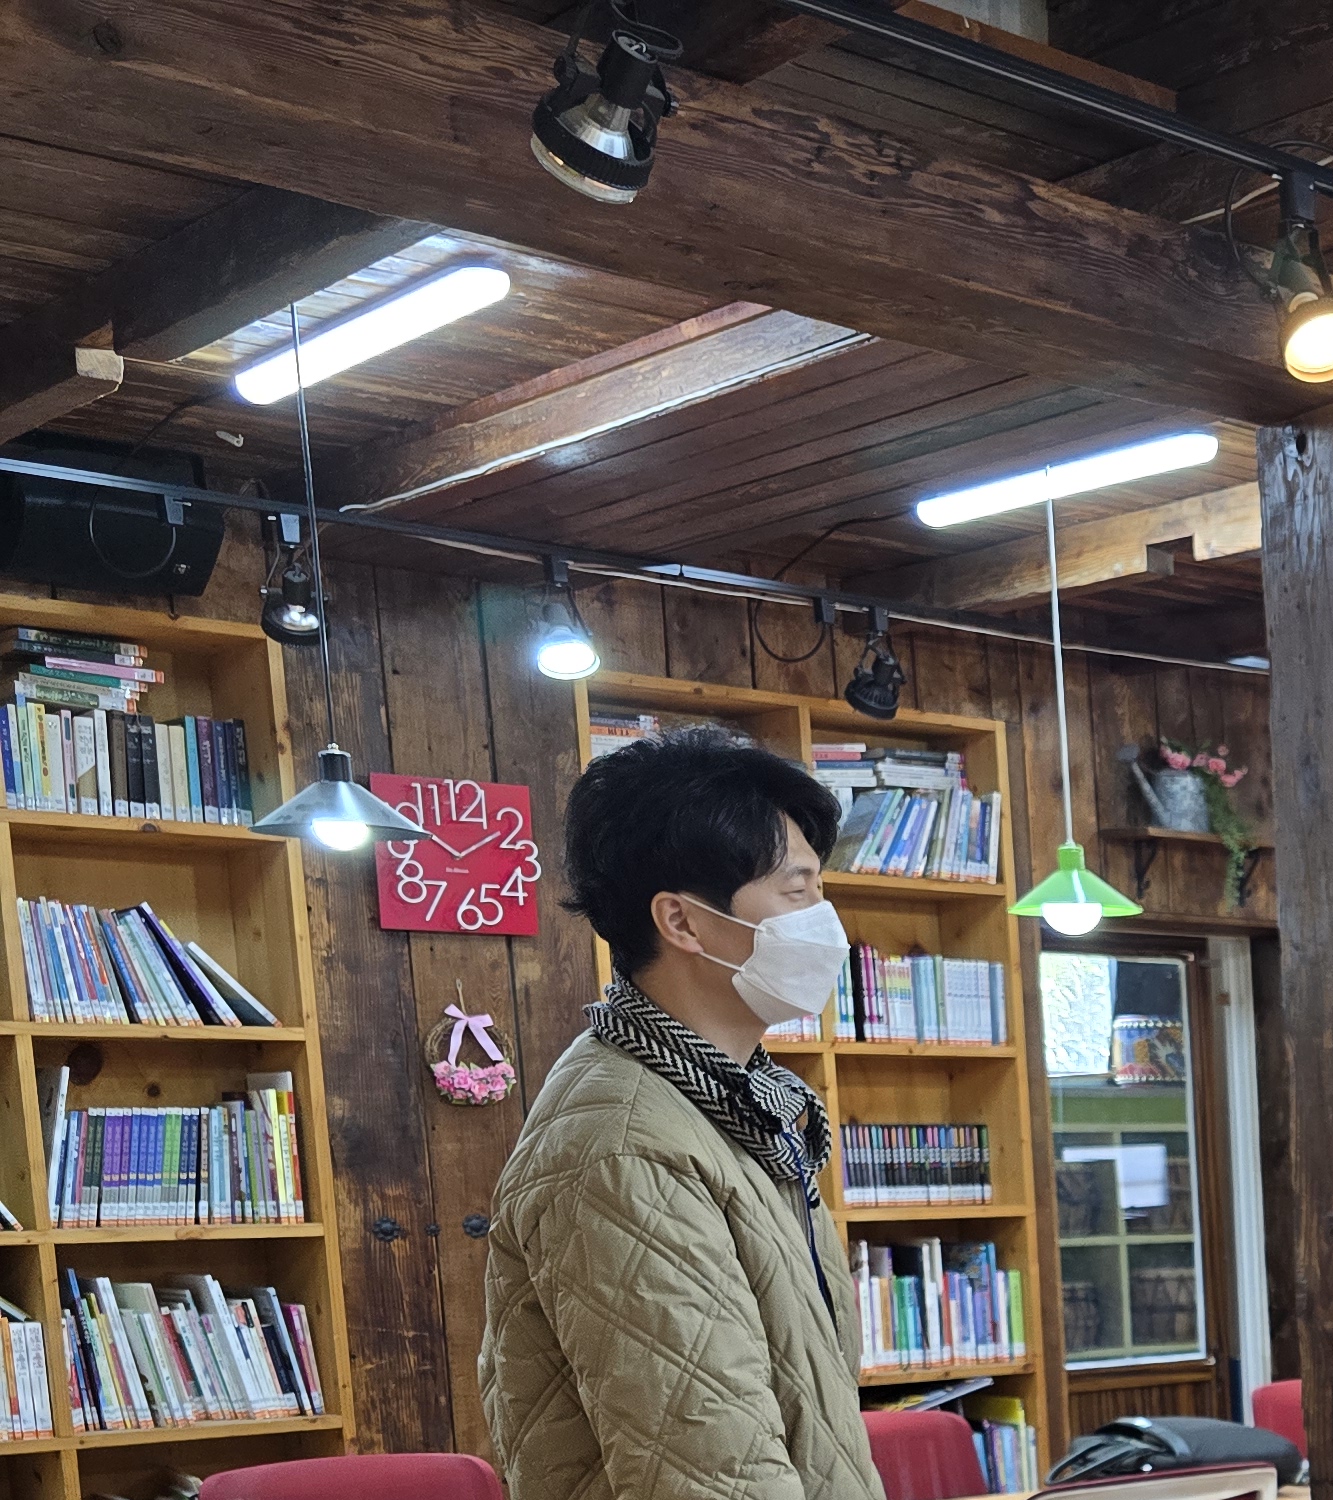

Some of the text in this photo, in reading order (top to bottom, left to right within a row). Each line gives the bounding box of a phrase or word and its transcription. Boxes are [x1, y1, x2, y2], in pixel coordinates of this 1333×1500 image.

[496, 807, 525, 850] 2
[397, 860, 428, 904] 8
[515, 839, 542, 882] 3
[422, 880, 447, 922] 7
[479, 883, 504, 926] 5
[500, 866, 529, 906] 4
[456, 887, 483, 931] 6
